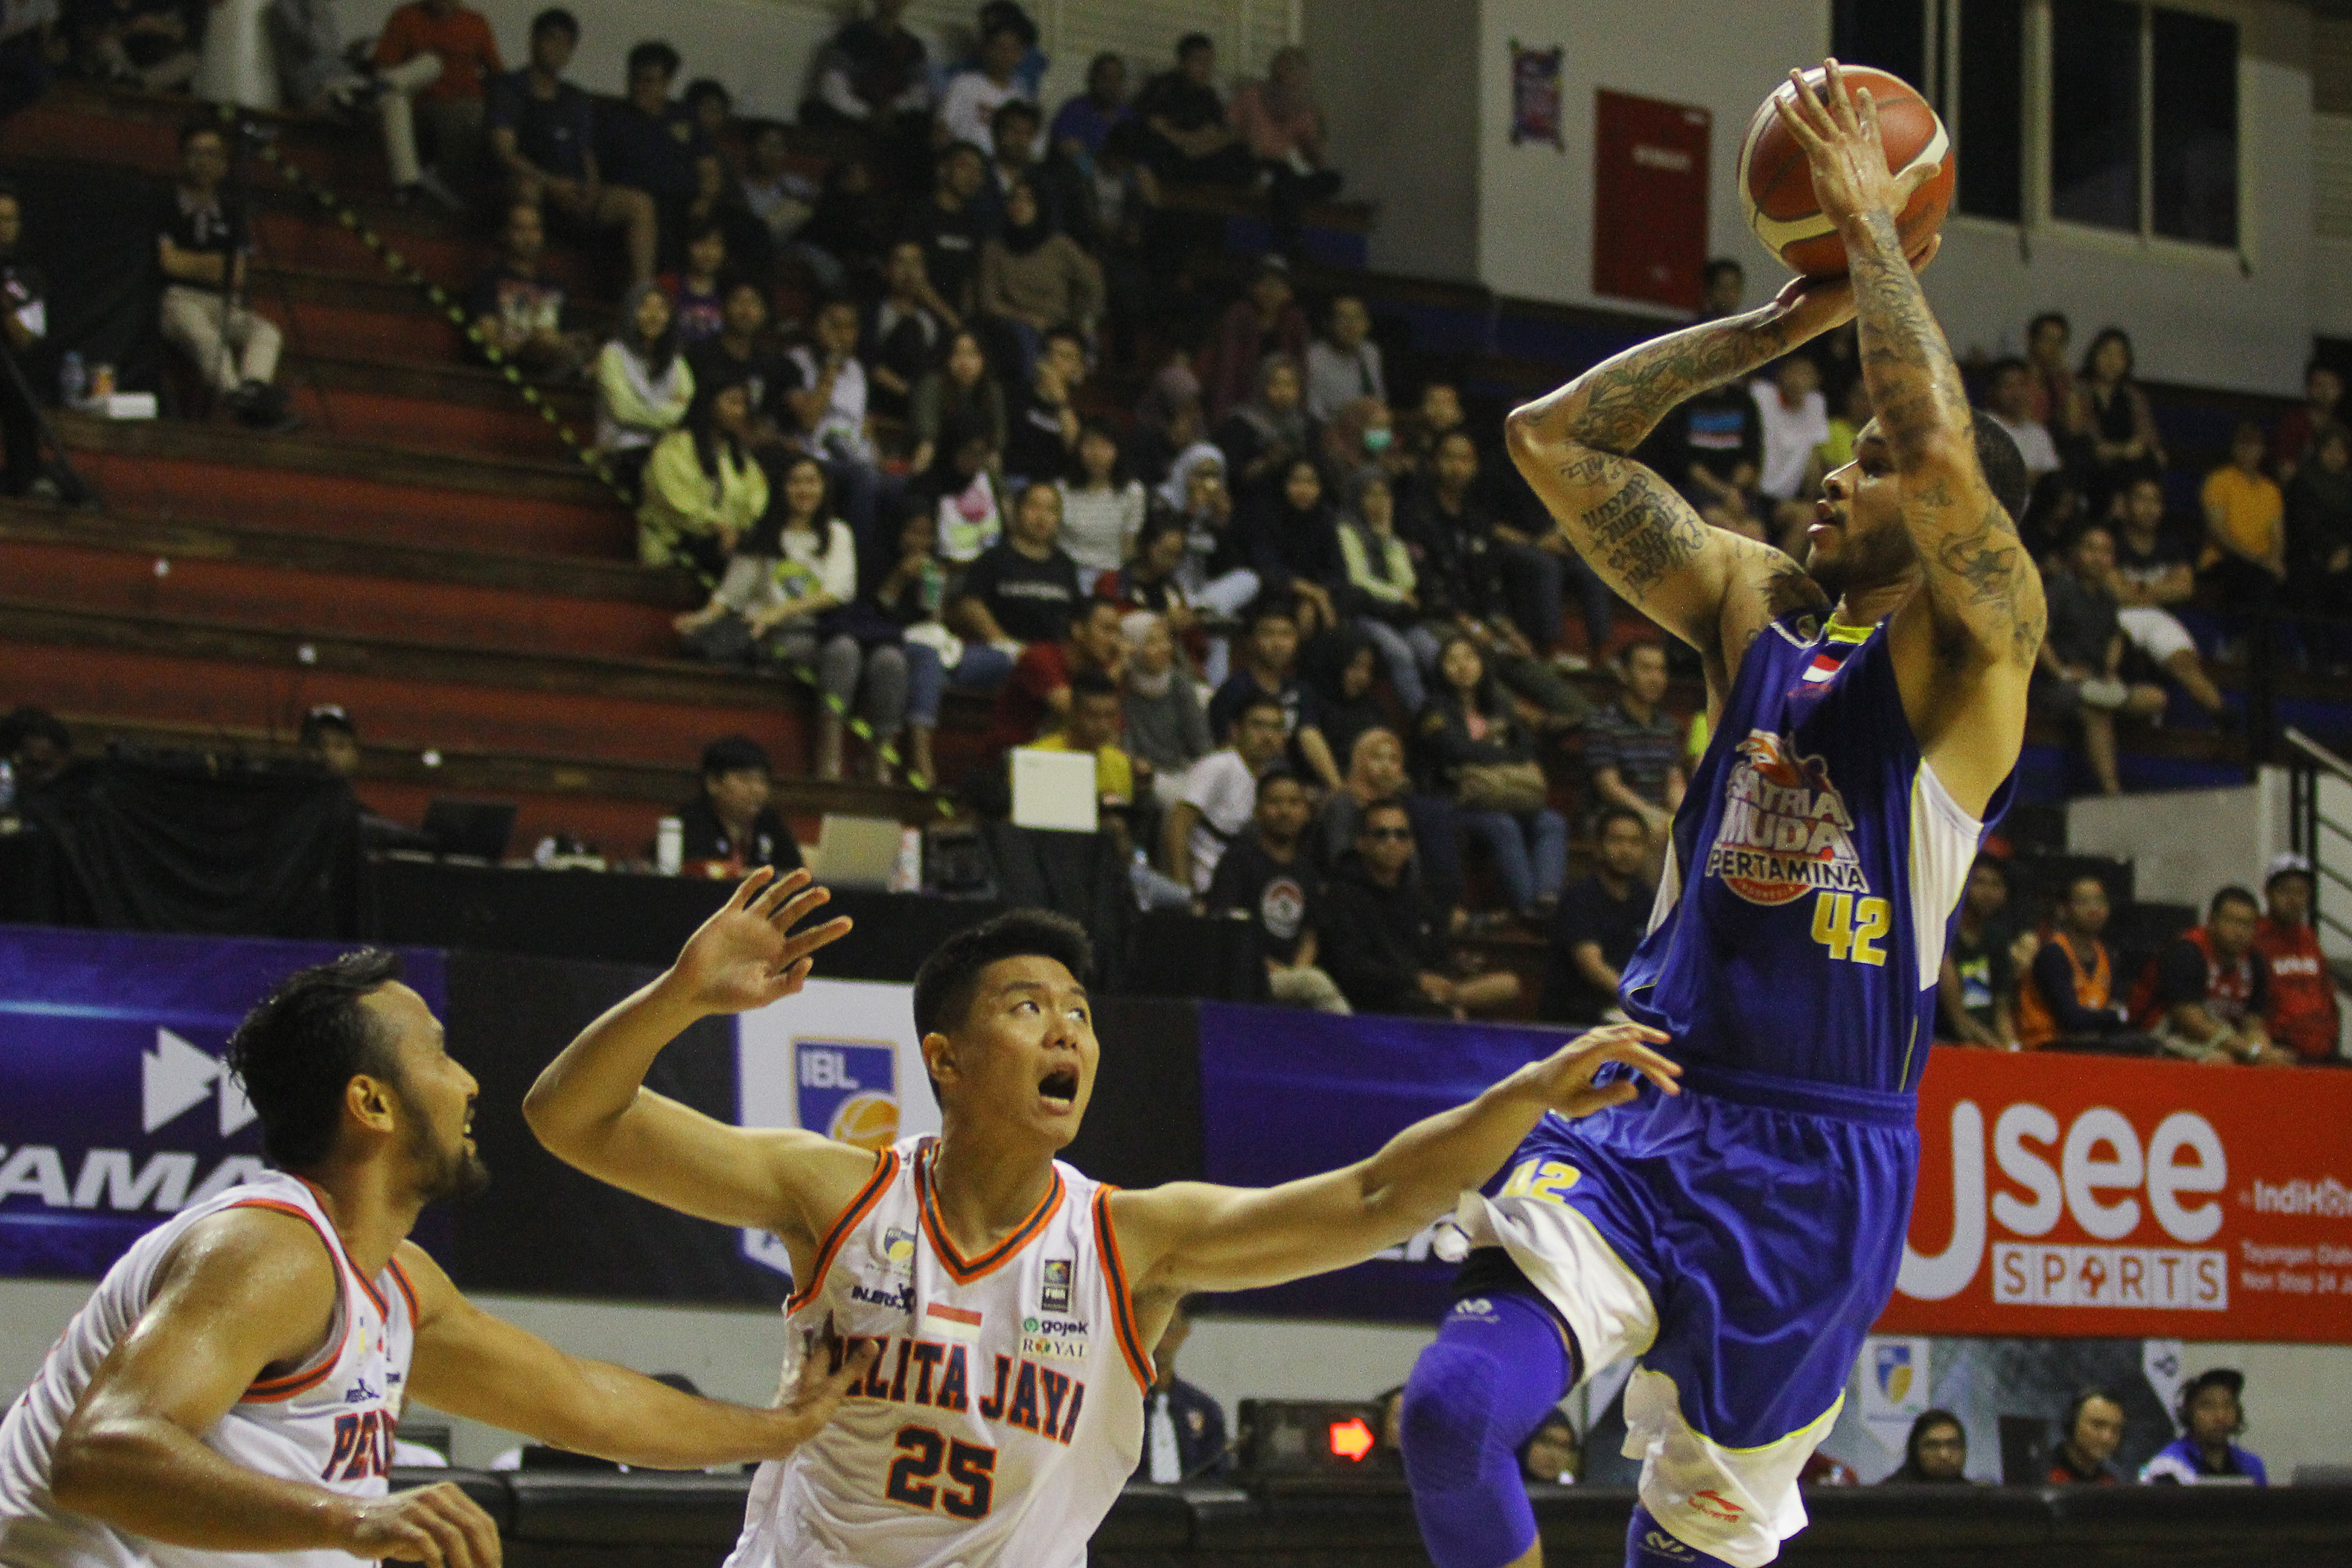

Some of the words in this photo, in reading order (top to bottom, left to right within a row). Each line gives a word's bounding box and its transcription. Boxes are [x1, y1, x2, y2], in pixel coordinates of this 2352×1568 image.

[1705, 847, 1870, 894] PERTAMINA
[1810, 890, 1892, 967] 42
[801, 1049, 860, 1090] IBL
[2002, 1251, 2220, 1301] SPORTS
[1041, 1320, 1087, 1337] gojek
[823, 1330, 970, 1414] LITA
[886, 1423, 998, 1522] 25
